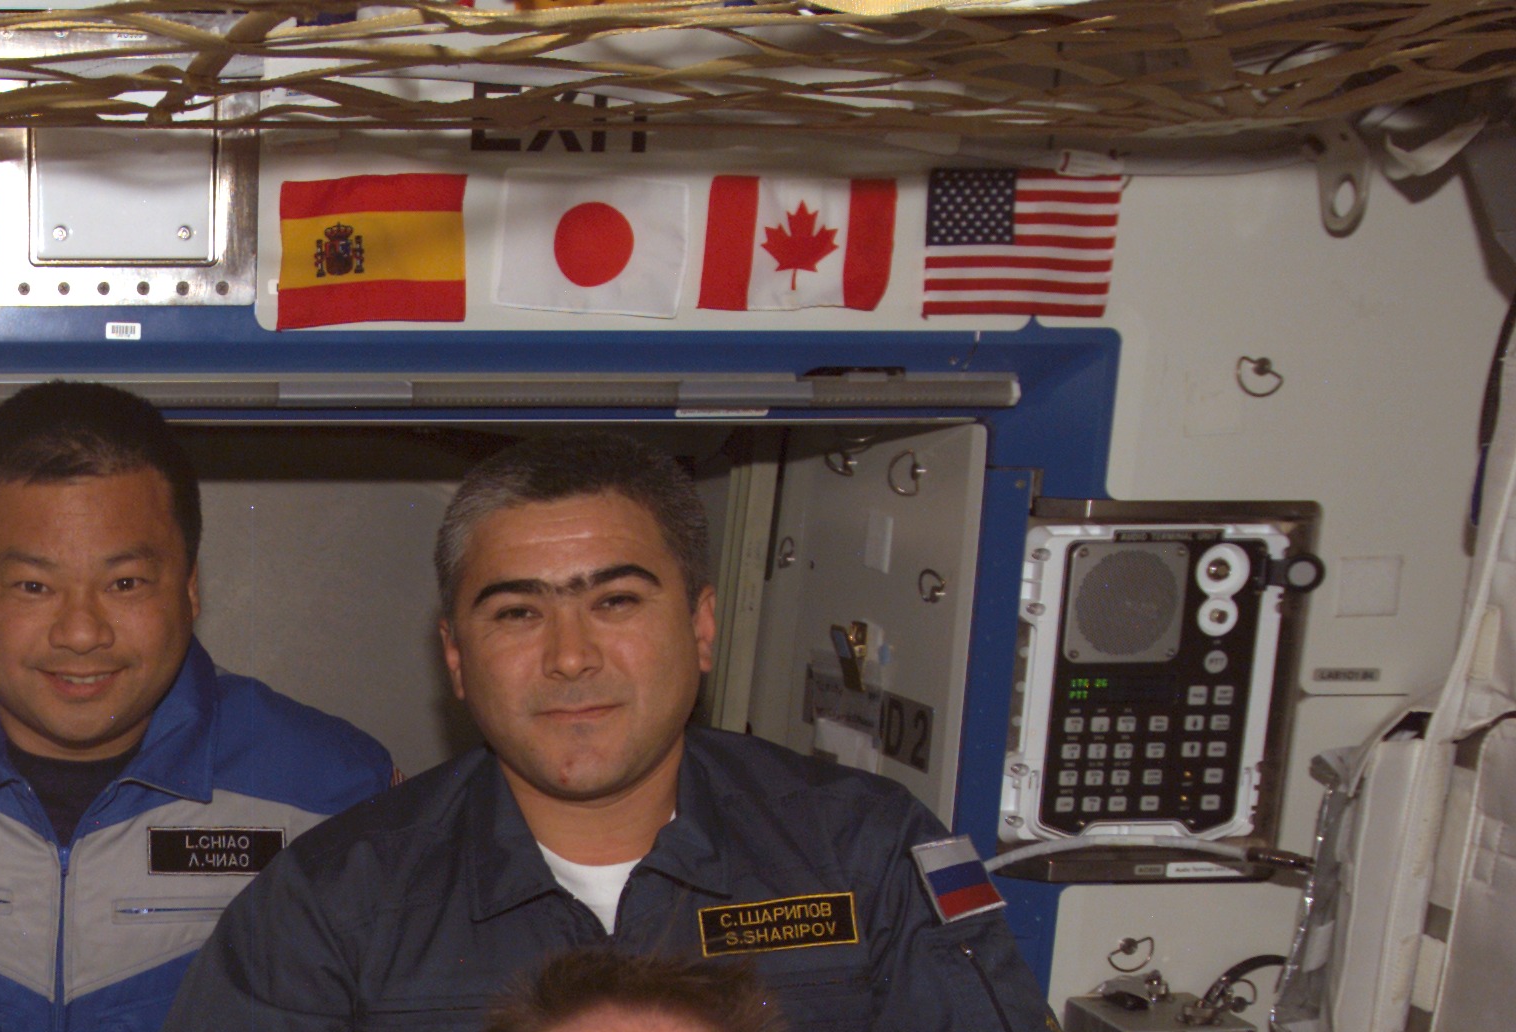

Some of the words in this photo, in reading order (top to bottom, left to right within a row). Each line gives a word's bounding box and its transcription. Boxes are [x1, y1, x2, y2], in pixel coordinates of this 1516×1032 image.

[185, 834, 250, 849] L.CHIAO
[720, 902, 832, 928] С.ШАРИПОВ
[726, 921, 836, 945] S.SHARIPOV
